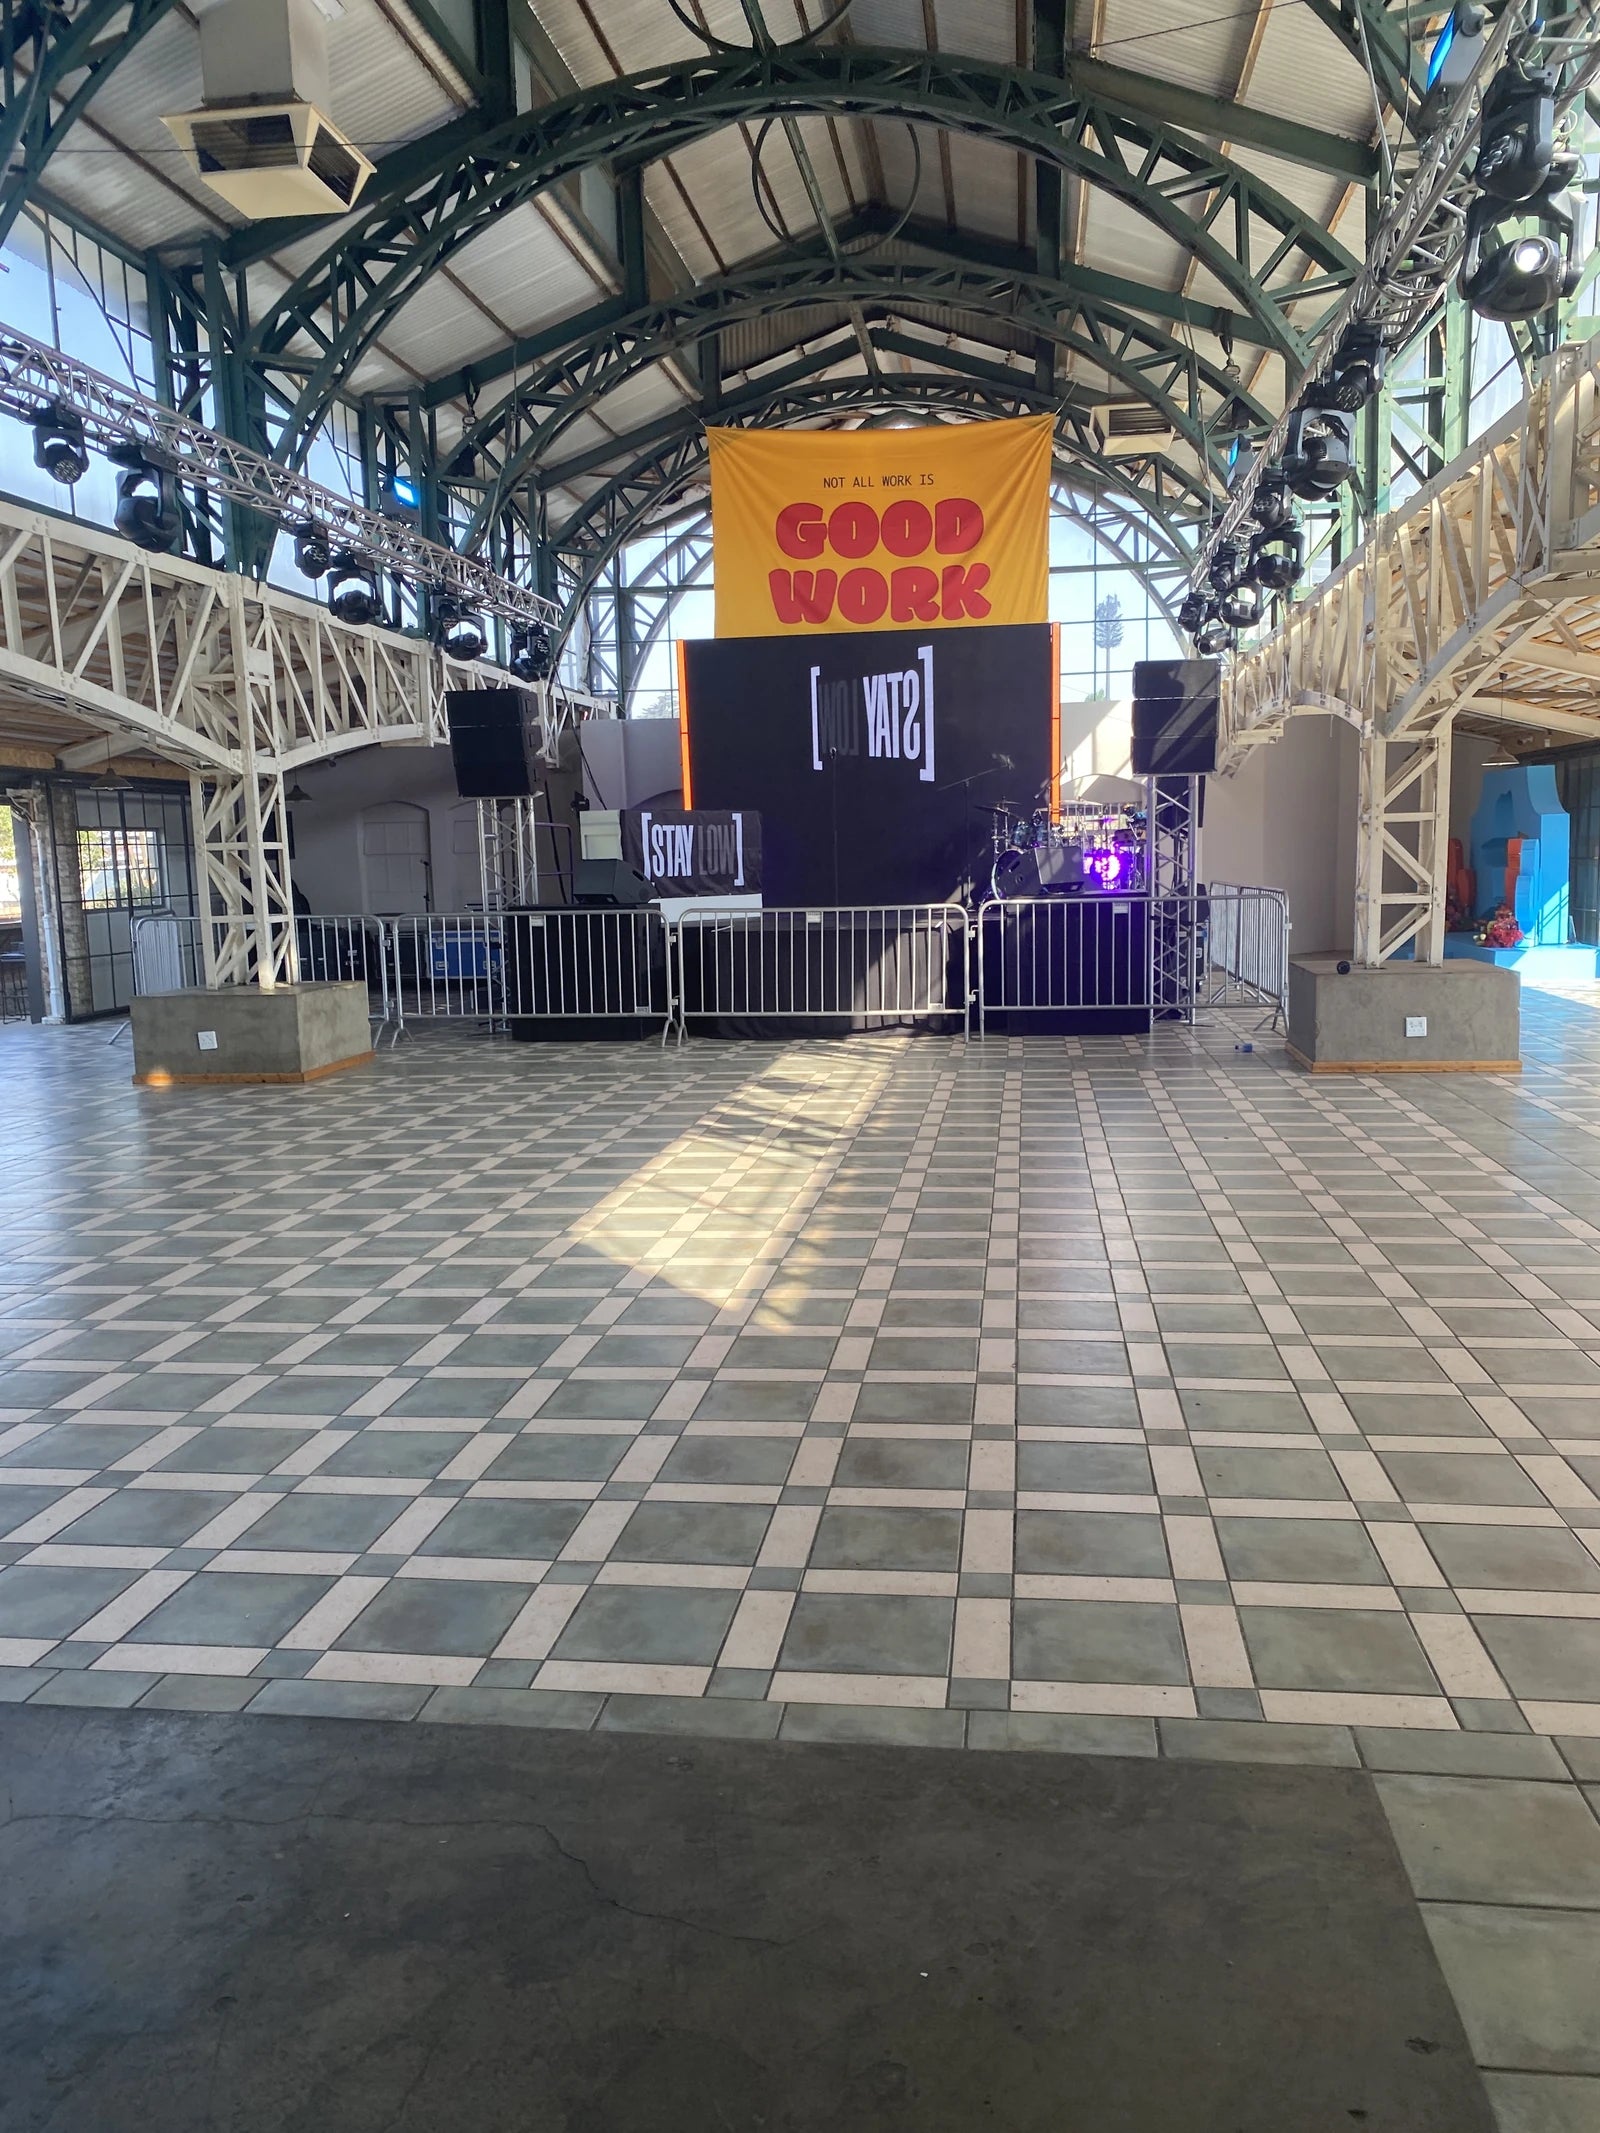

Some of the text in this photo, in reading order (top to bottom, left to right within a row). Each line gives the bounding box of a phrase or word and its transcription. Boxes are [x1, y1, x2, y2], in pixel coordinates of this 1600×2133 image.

[823, 473, 935, 489] NOT ALL WORK IS
[775, 498, 984, 560] GOOD
[768, 563, 992, 625] WORK
